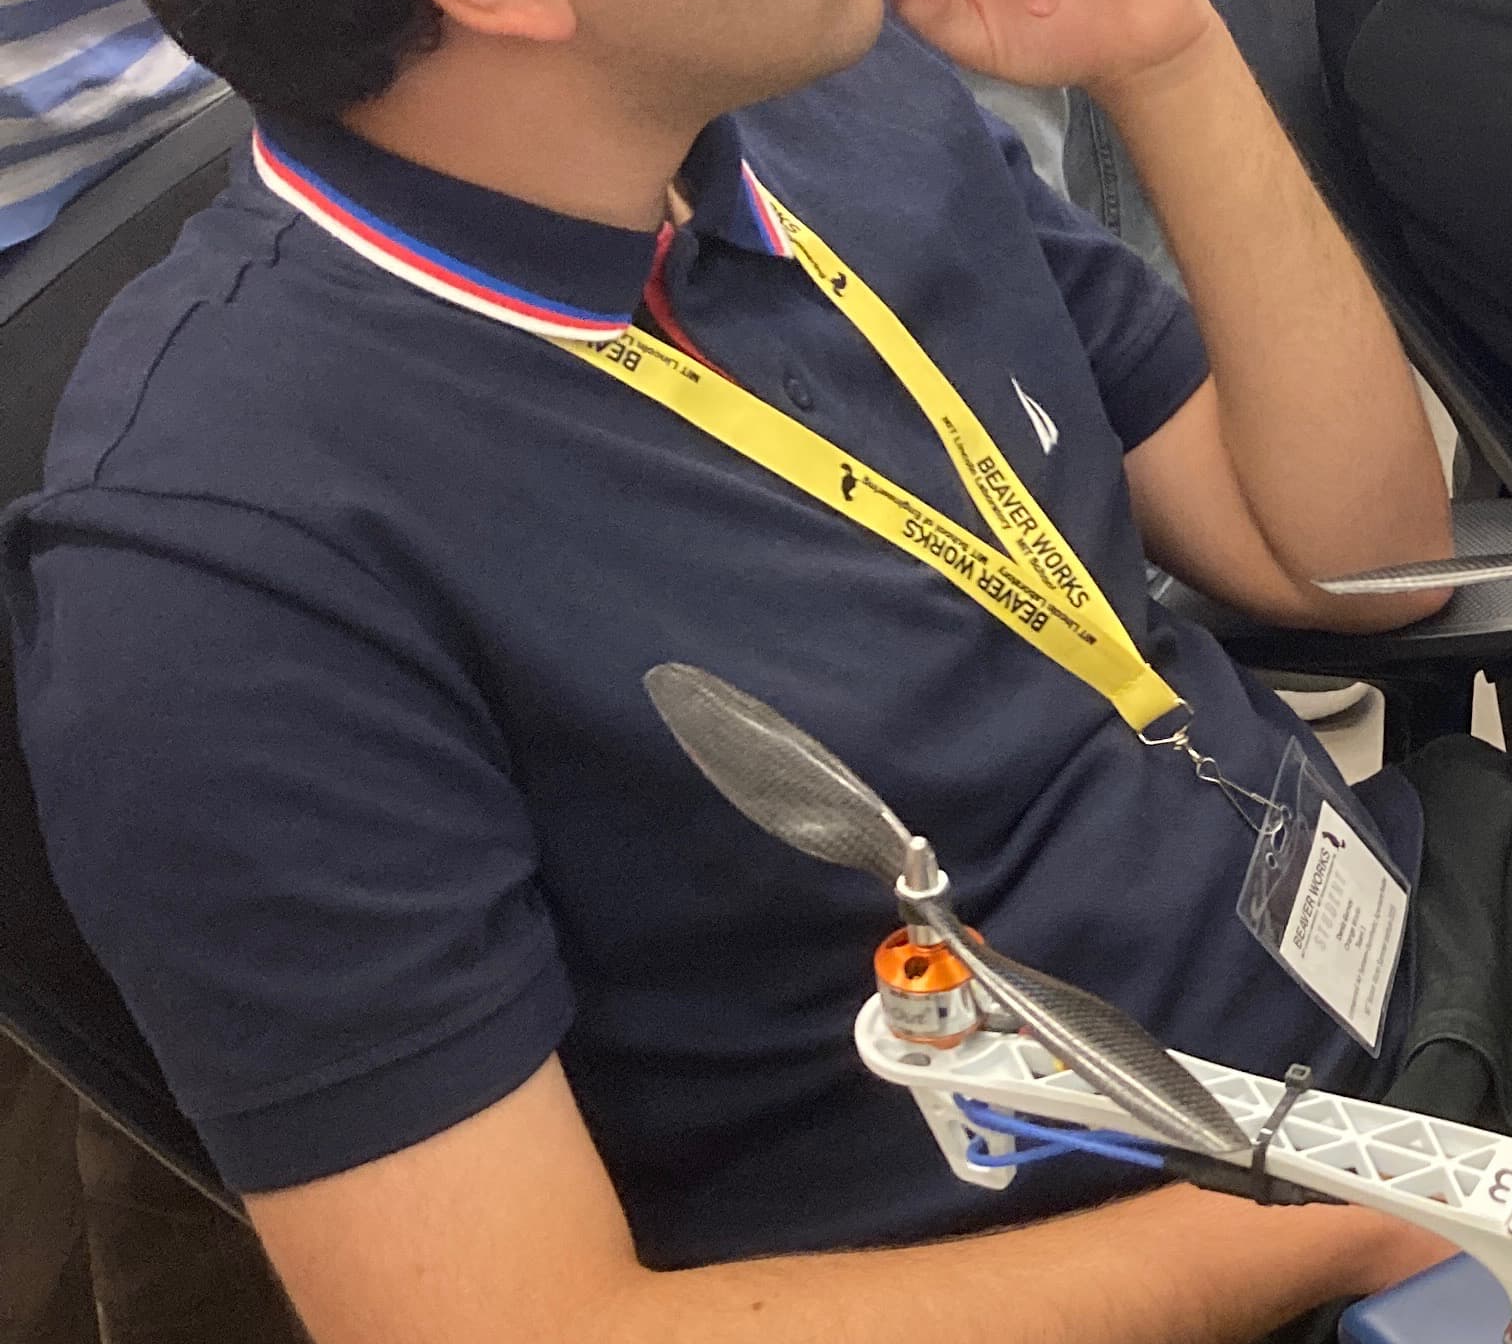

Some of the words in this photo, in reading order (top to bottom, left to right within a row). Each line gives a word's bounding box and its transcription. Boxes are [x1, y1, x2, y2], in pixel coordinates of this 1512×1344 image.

[974, 476, 1012, 530] Laboratory
[977, 455, 1038, 536] BEAVER
[1032, 532, 1090, 608] WORKS
[902, 519, 975, 580] WORKS
[977, 568, 1049, 632] BEAVER
[998, 566, 1047, 608] Laboratory
[1293, 895, 1316, 950] BEAVER
[1309, 847, 1331, 897] WORKS
